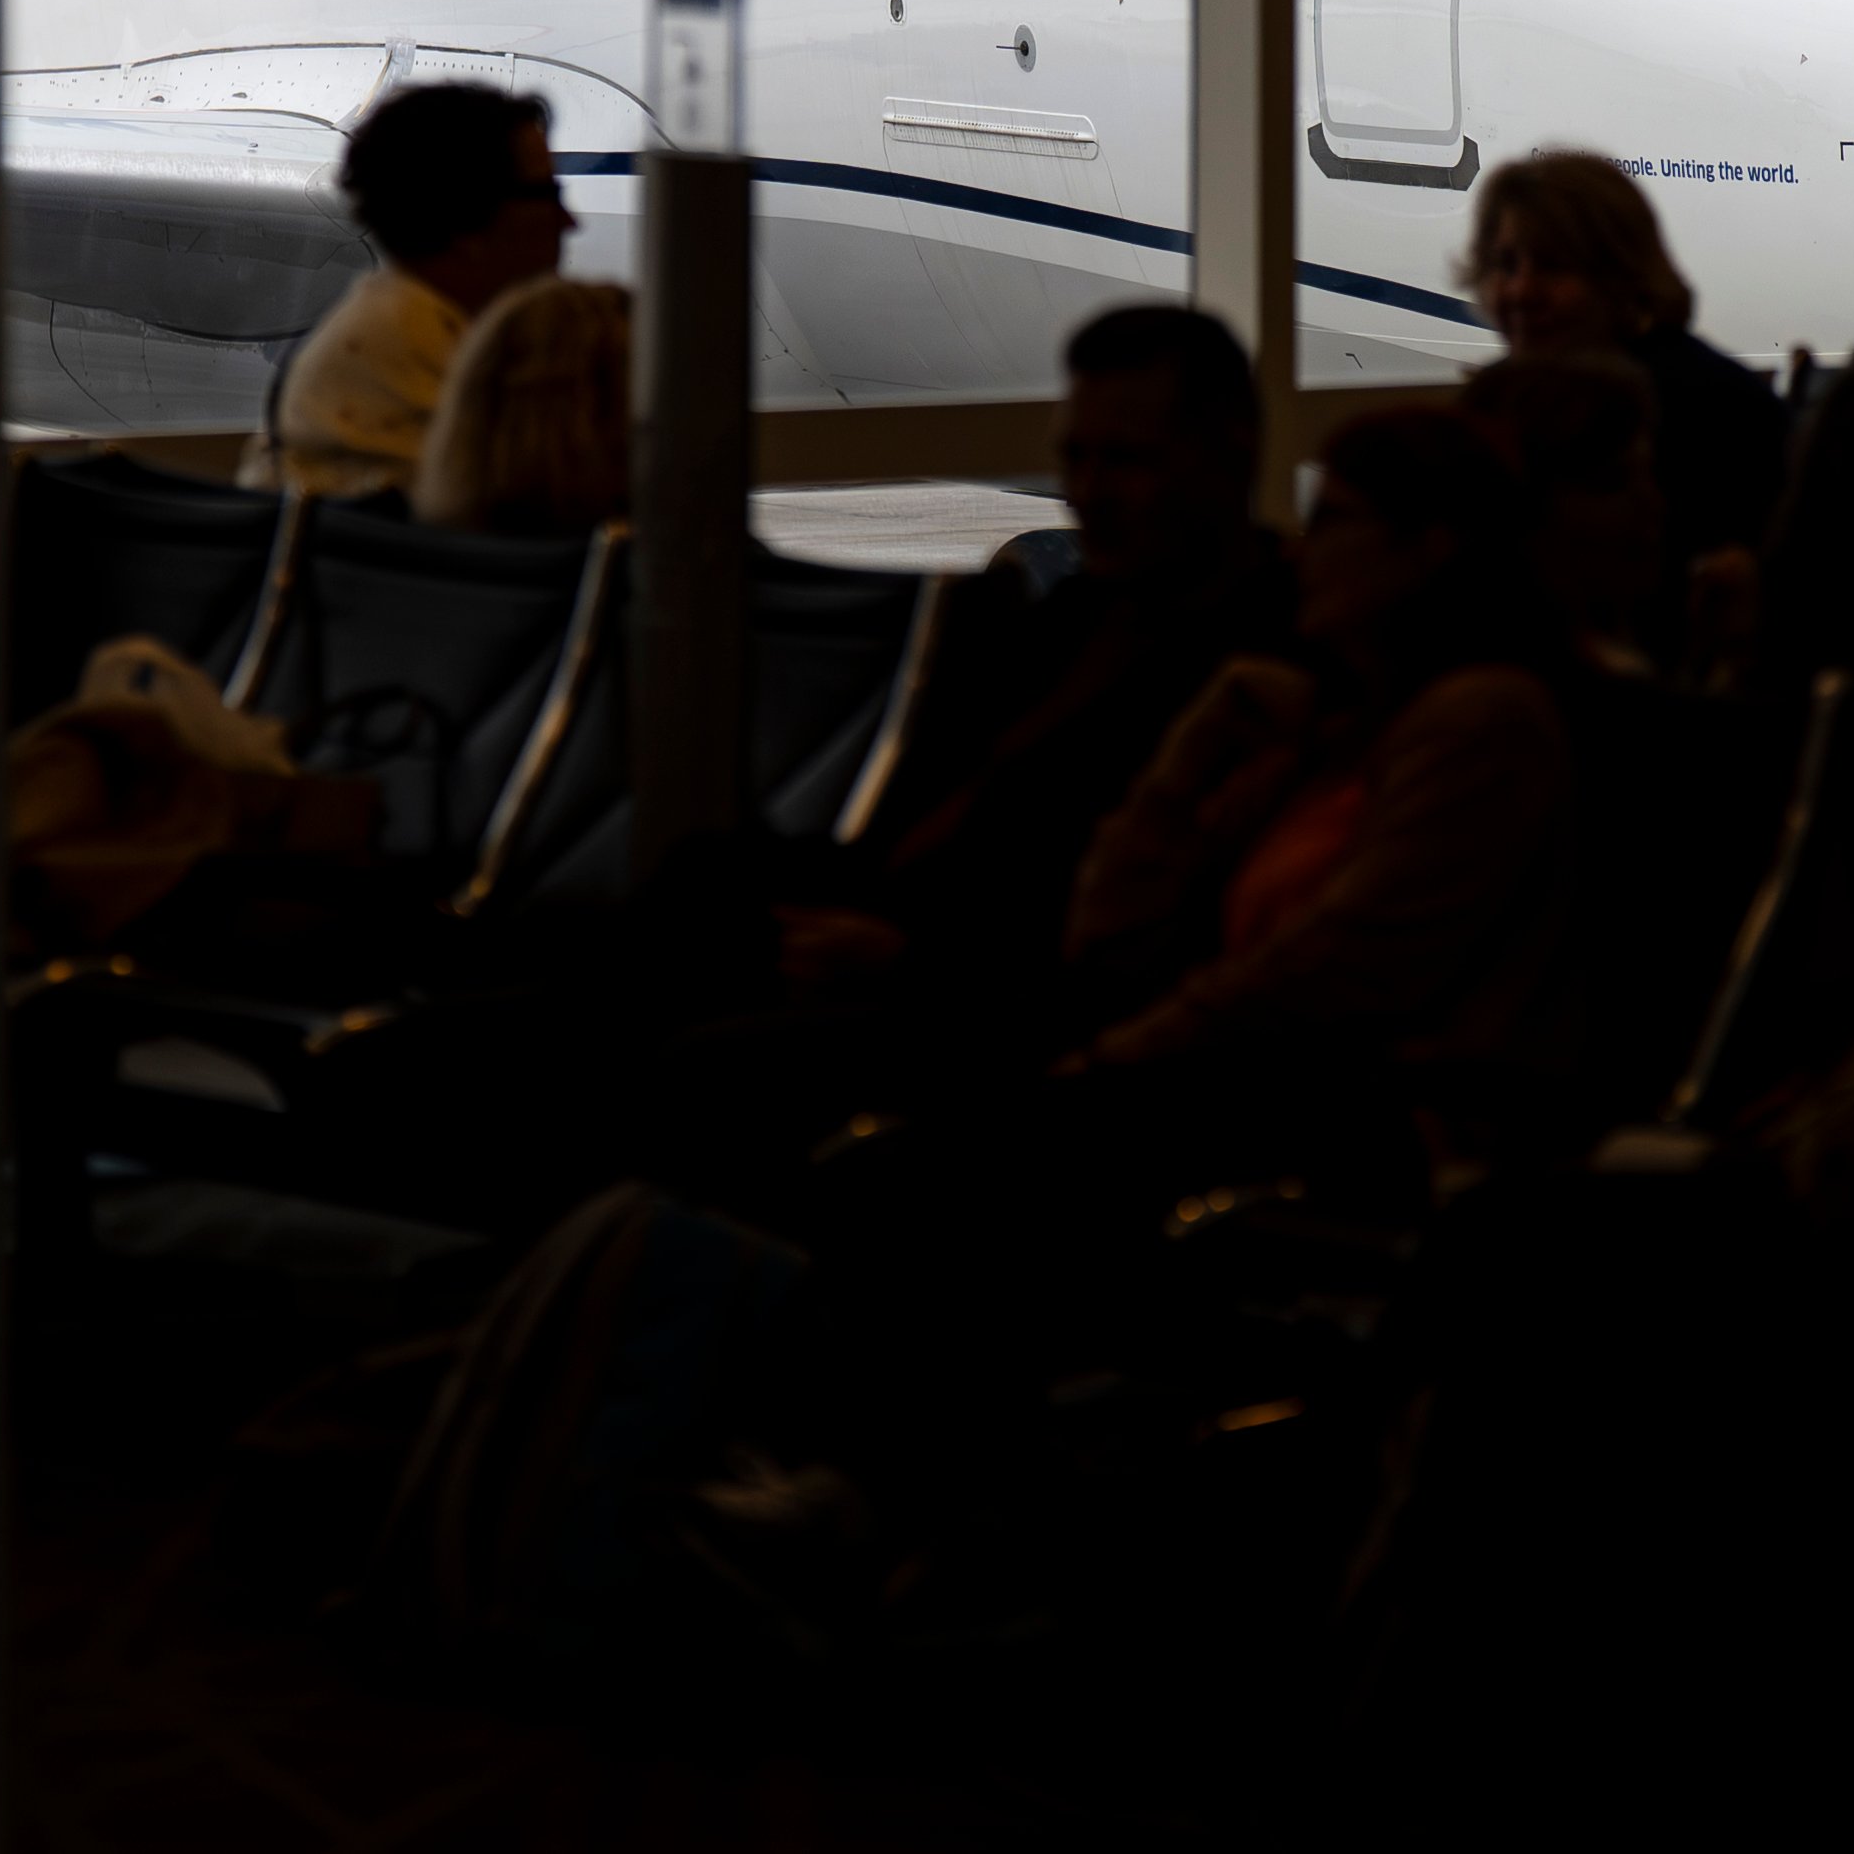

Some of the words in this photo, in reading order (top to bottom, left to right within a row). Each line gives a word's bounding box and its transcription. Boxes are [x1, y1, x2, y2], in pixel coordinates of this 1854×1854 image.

[1660, 158, 1715, 182] Uniting
[1718, 161, 1744, 181] the
[1747, 163, 1799, 184] world.
